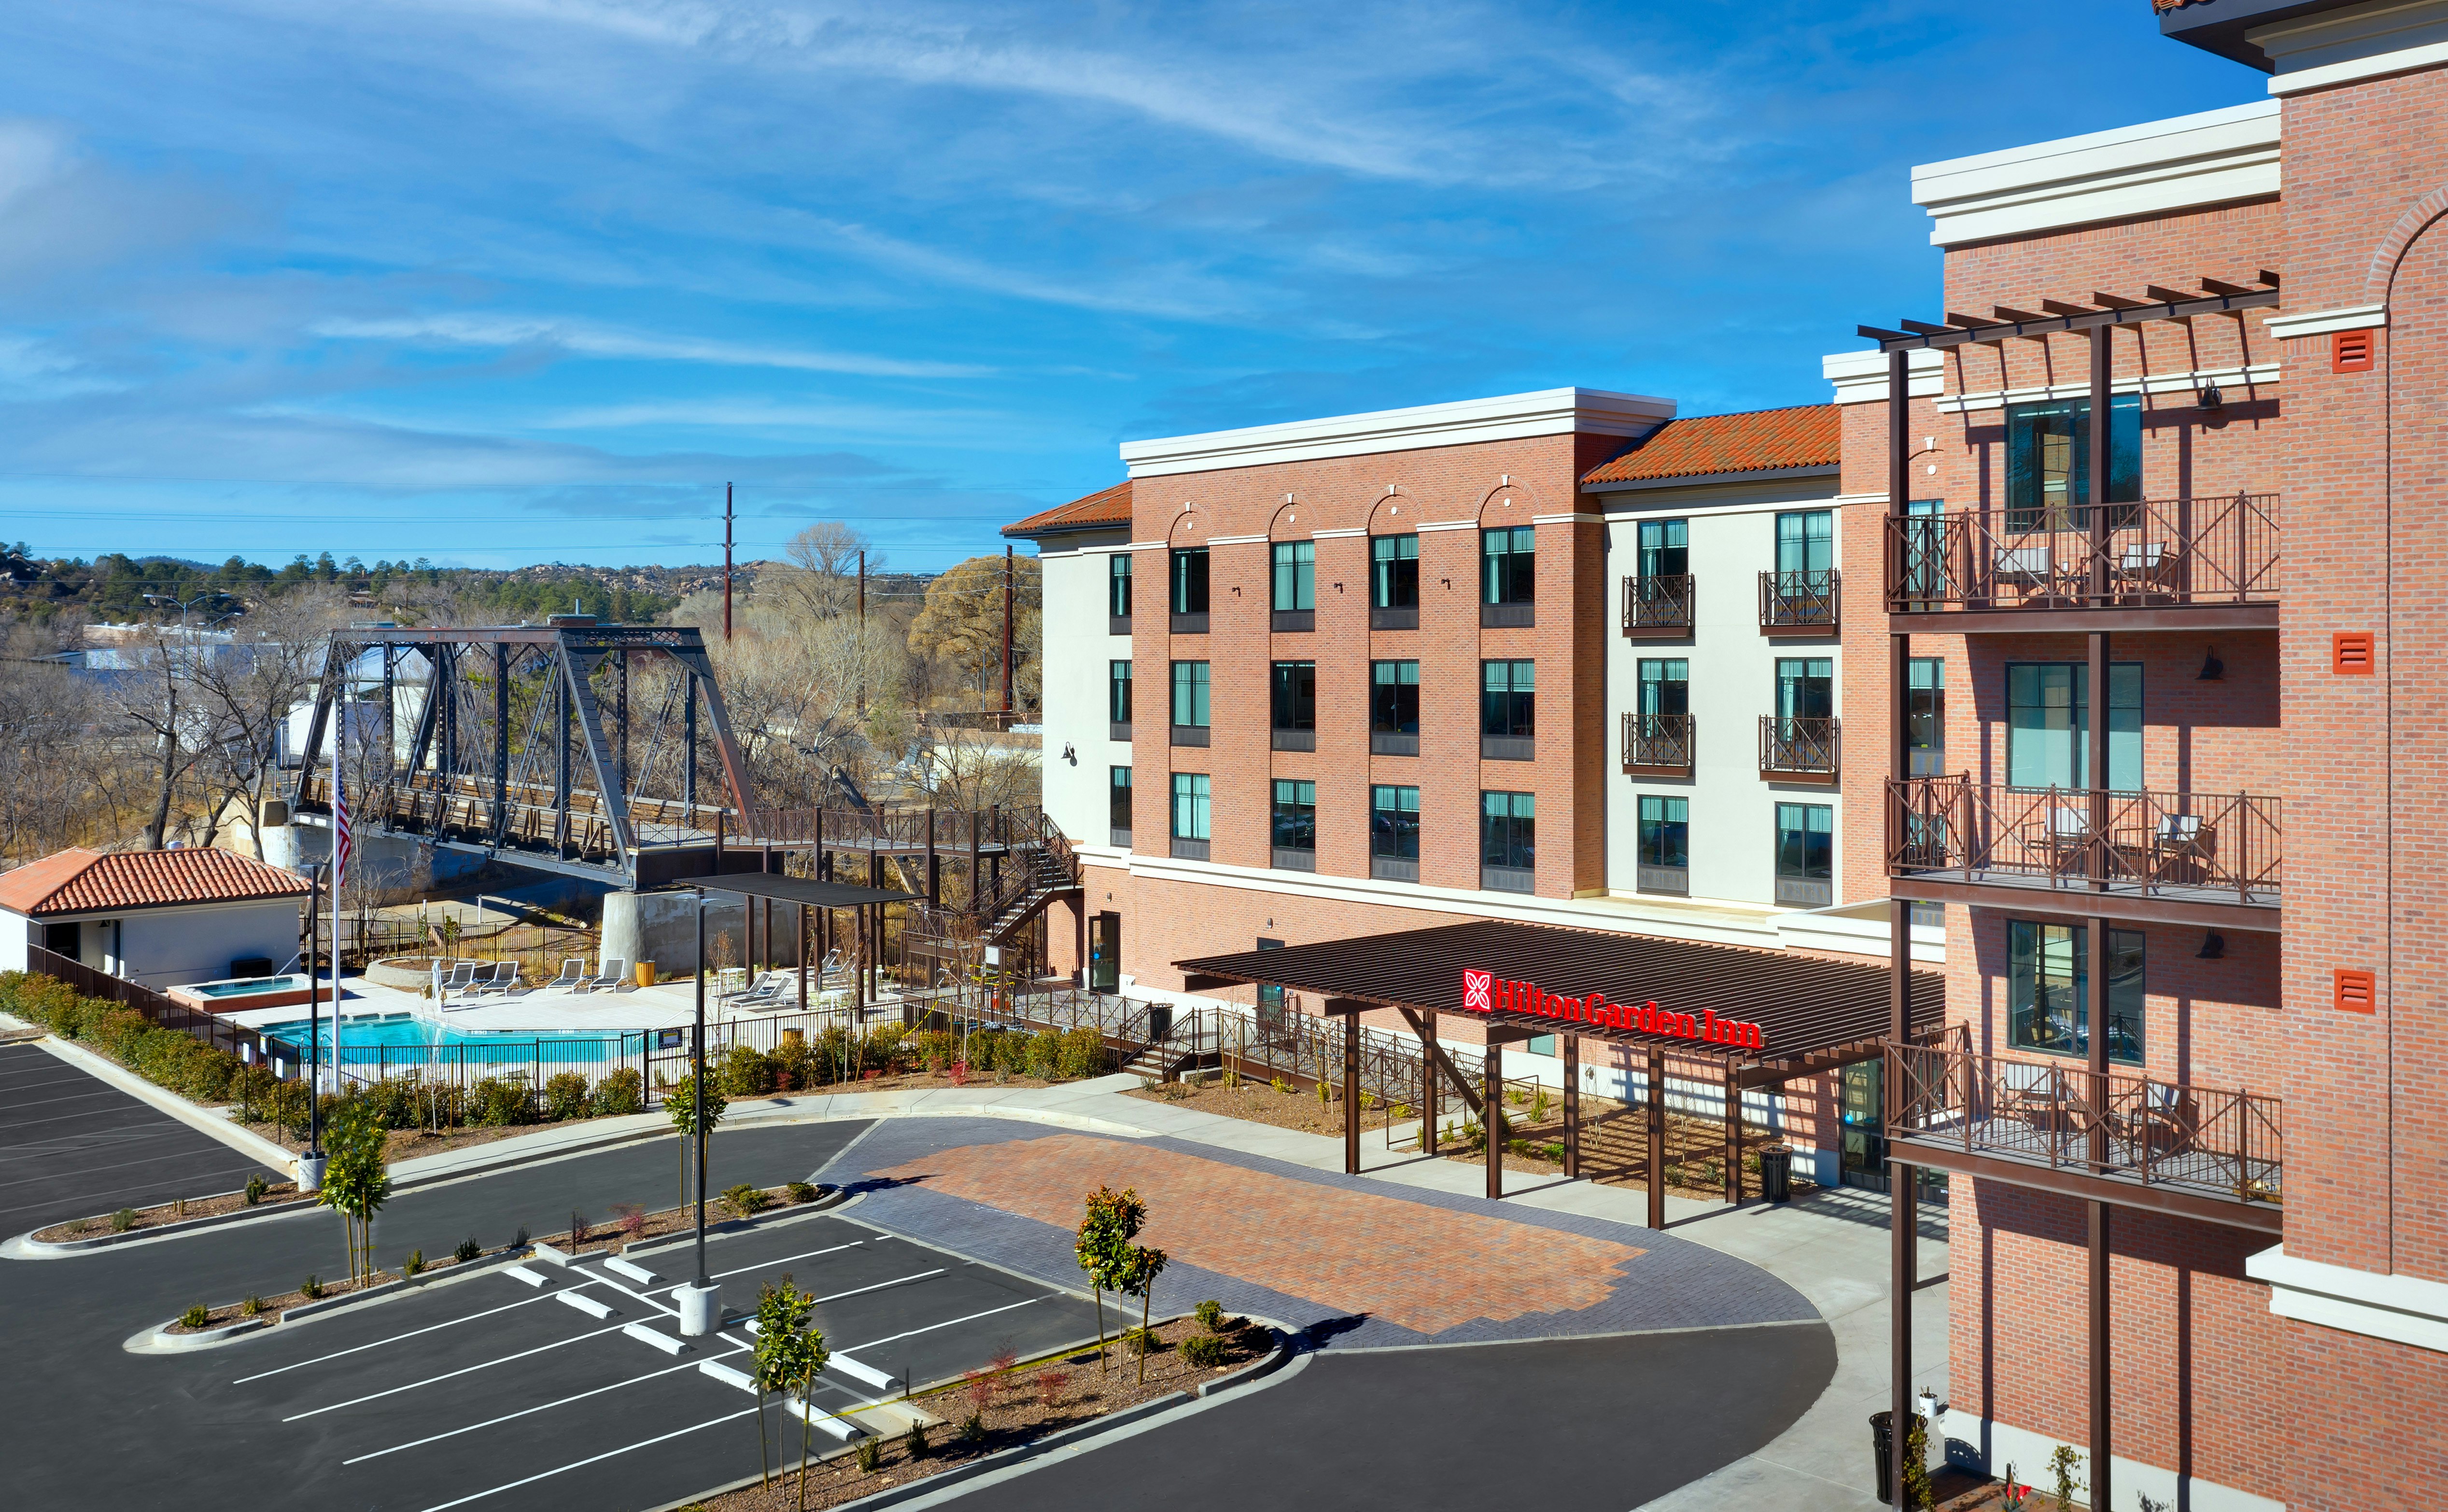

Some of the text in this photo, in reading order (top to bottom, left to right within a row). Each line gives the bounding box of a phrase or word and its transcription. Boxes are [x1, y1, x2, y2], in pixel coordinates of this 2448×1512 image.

[1494, 979, 1763, 1049] Hilton Garden Inn
